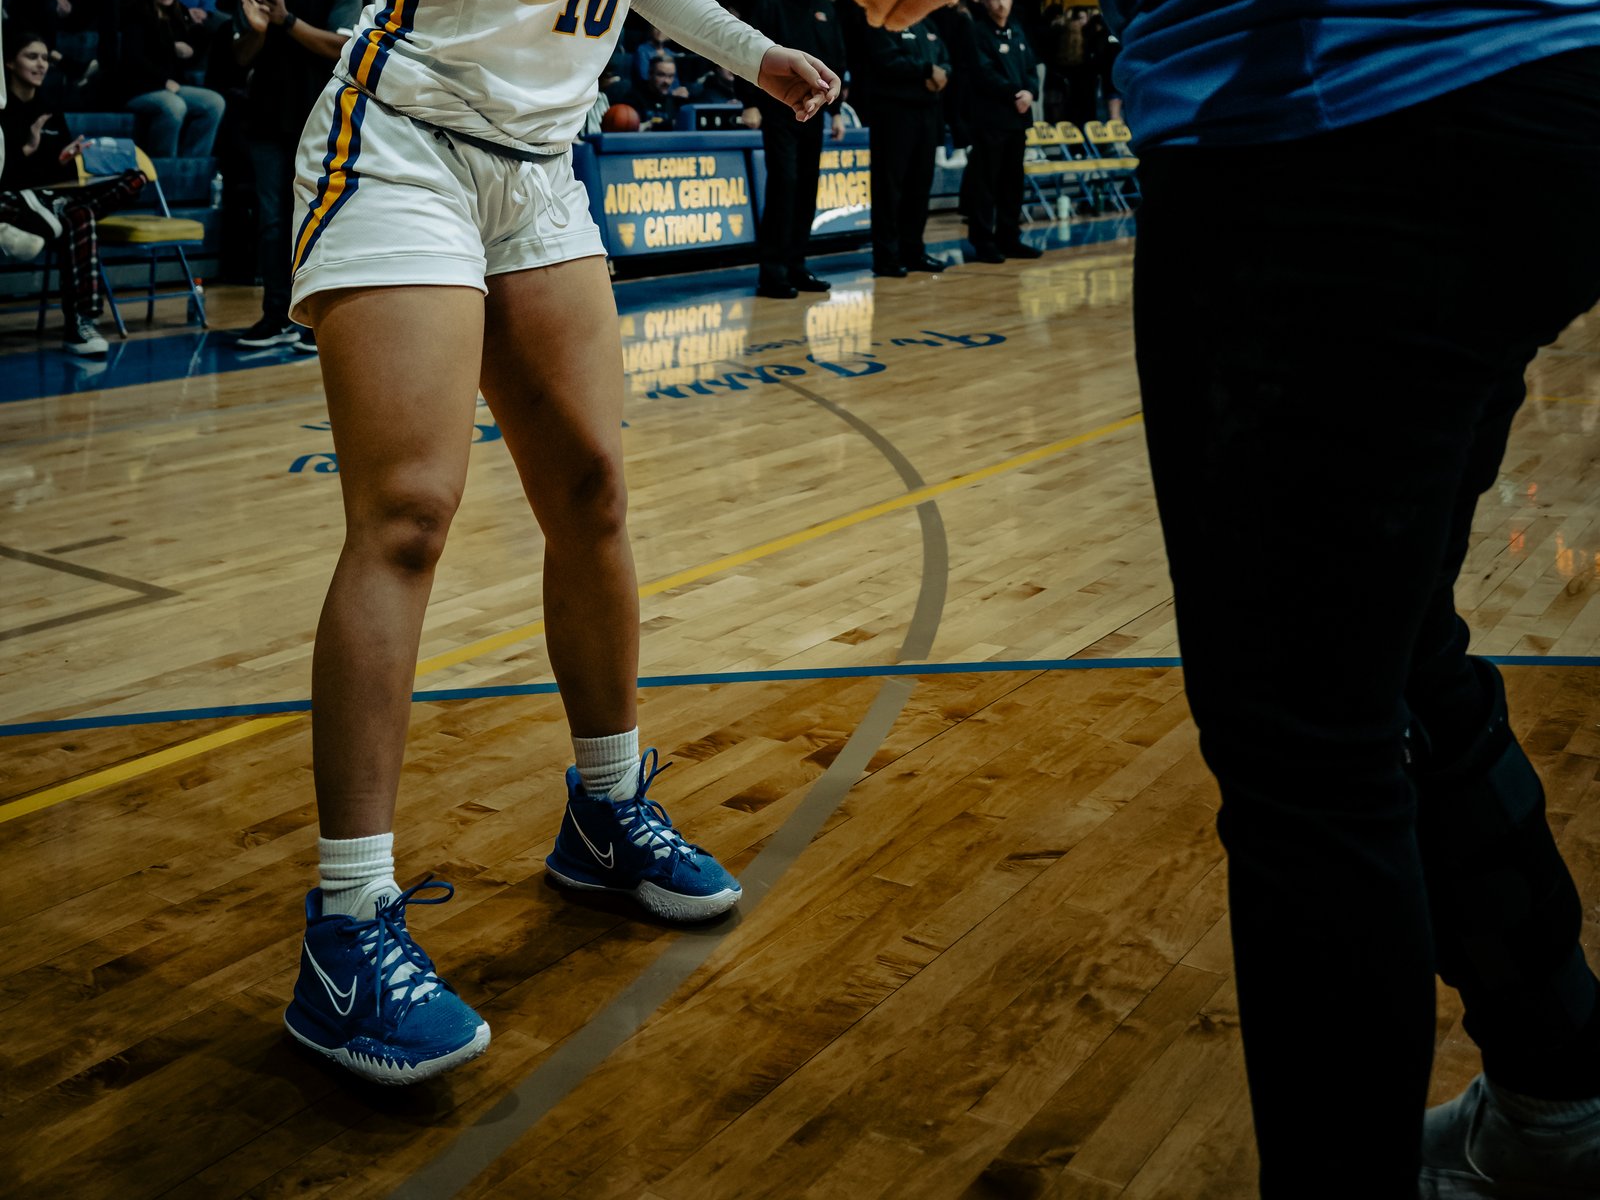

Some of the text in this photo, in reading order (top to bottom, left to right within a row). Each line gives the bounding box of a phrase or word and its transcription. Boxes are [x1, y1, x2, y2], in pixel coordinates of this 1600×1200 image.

[632, 155, 716, 179] WELCOME TO
[604, 176, 748, 215] AURORA CENTRAL
[644, 211, 722, 248] CATHOLIC
